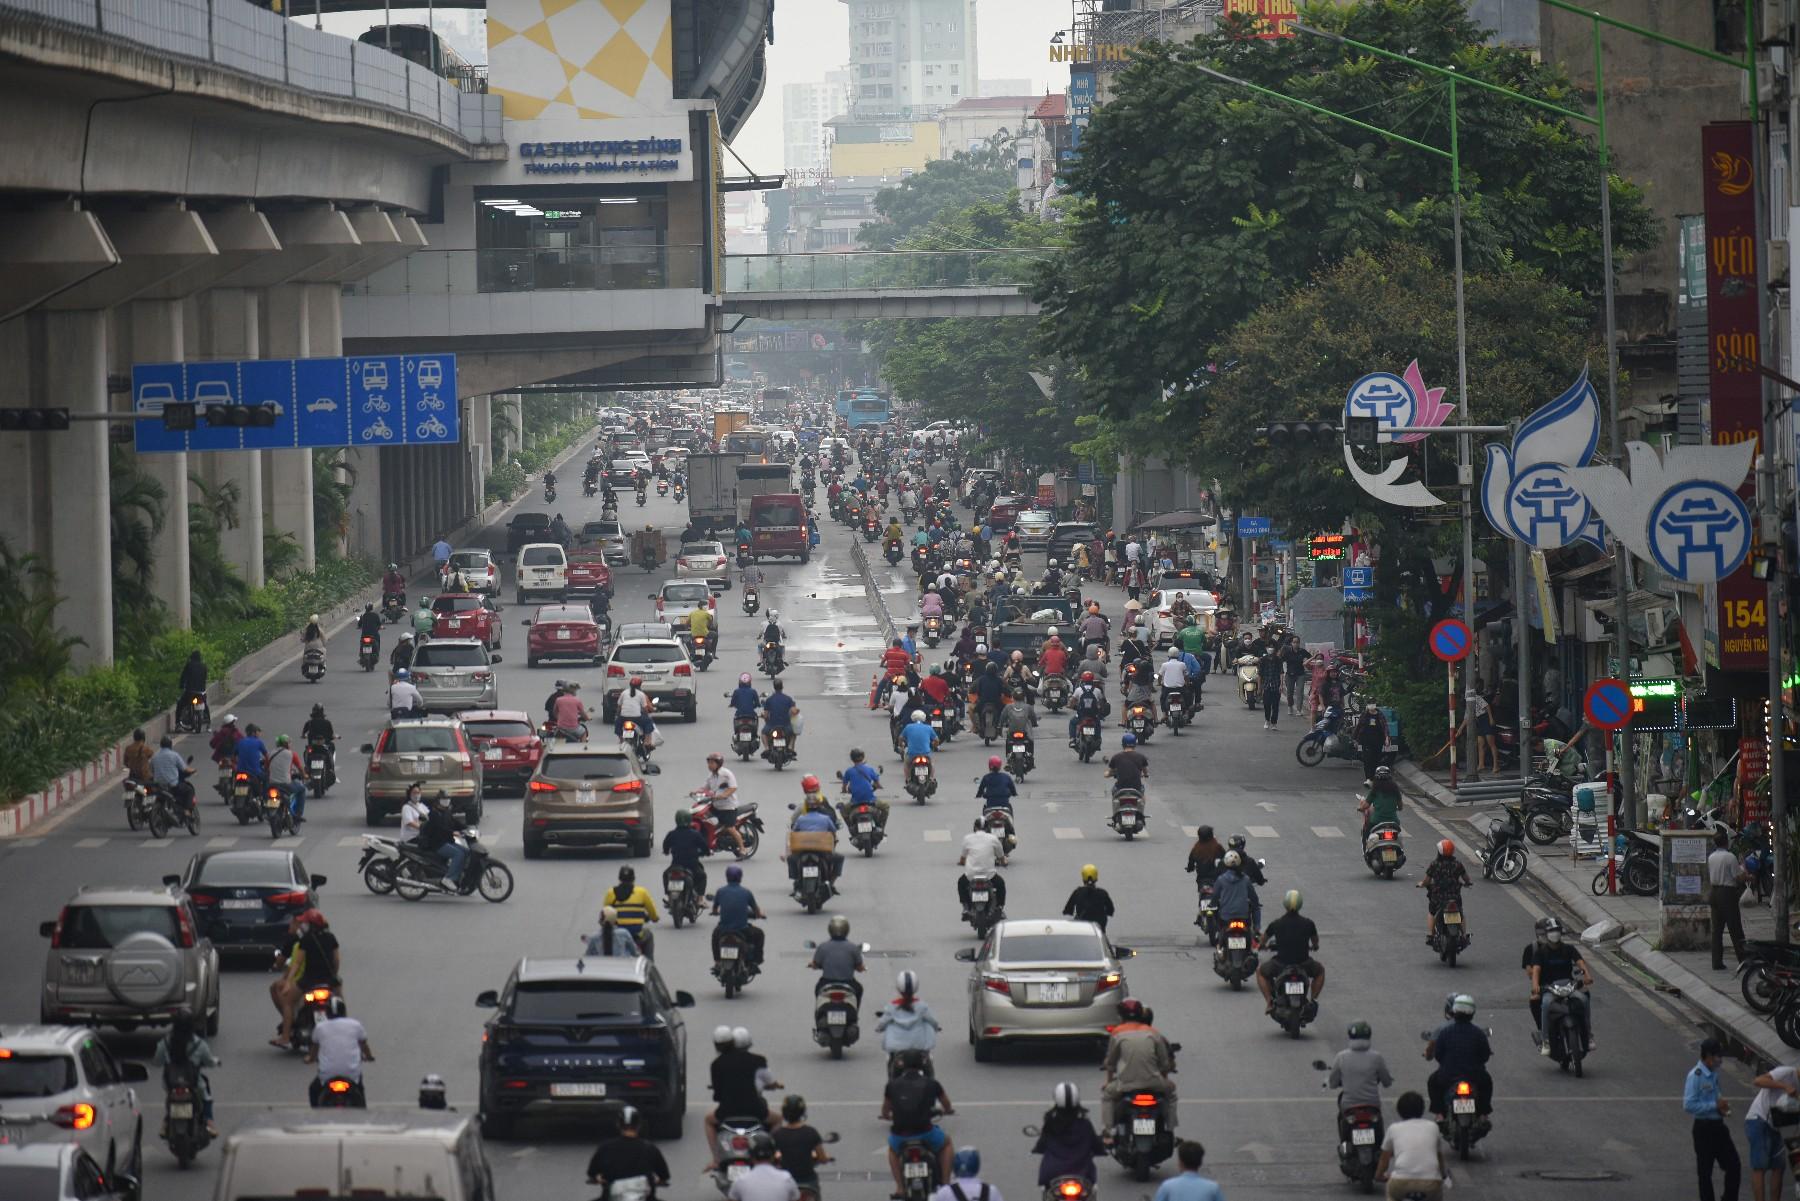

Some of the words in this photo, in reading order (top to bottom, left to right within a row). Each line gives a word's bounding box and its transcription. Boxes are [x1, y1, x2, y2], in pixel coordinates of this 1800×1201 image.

[520, 142, 545, 157] GA
[620, 159, 678, 172] STATION
[1724, 600, 1767, 628] 154
